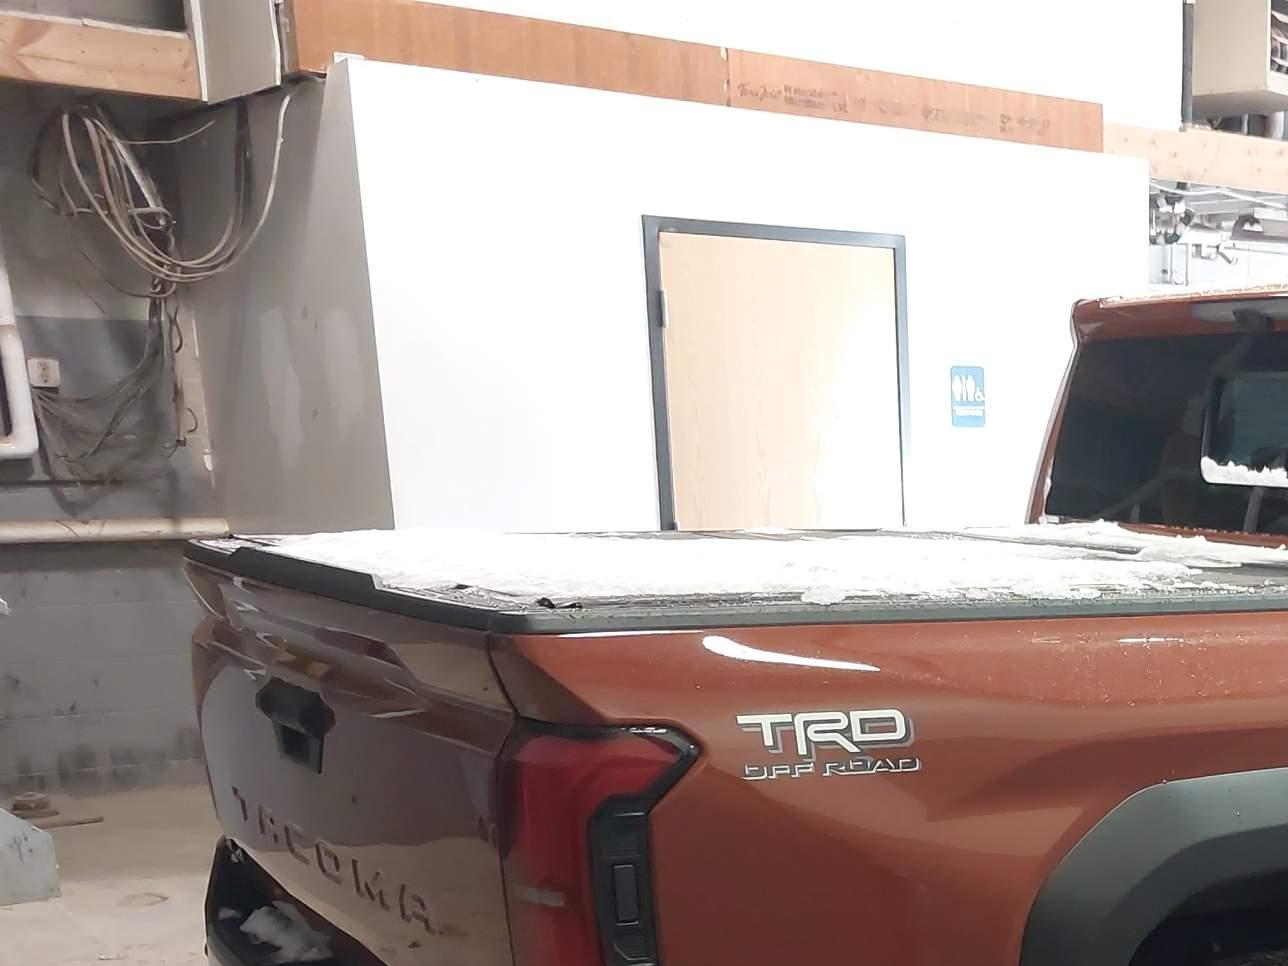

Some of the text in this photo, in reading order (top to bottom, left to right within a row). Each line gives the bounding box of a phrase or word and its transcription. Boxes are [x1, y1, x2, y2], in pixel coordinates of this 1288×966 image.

[736, 708, 912, 757] TRD
[741, 756, 921, 781] OFF ROAD
[231, 785, 437, 936] TACOMA
